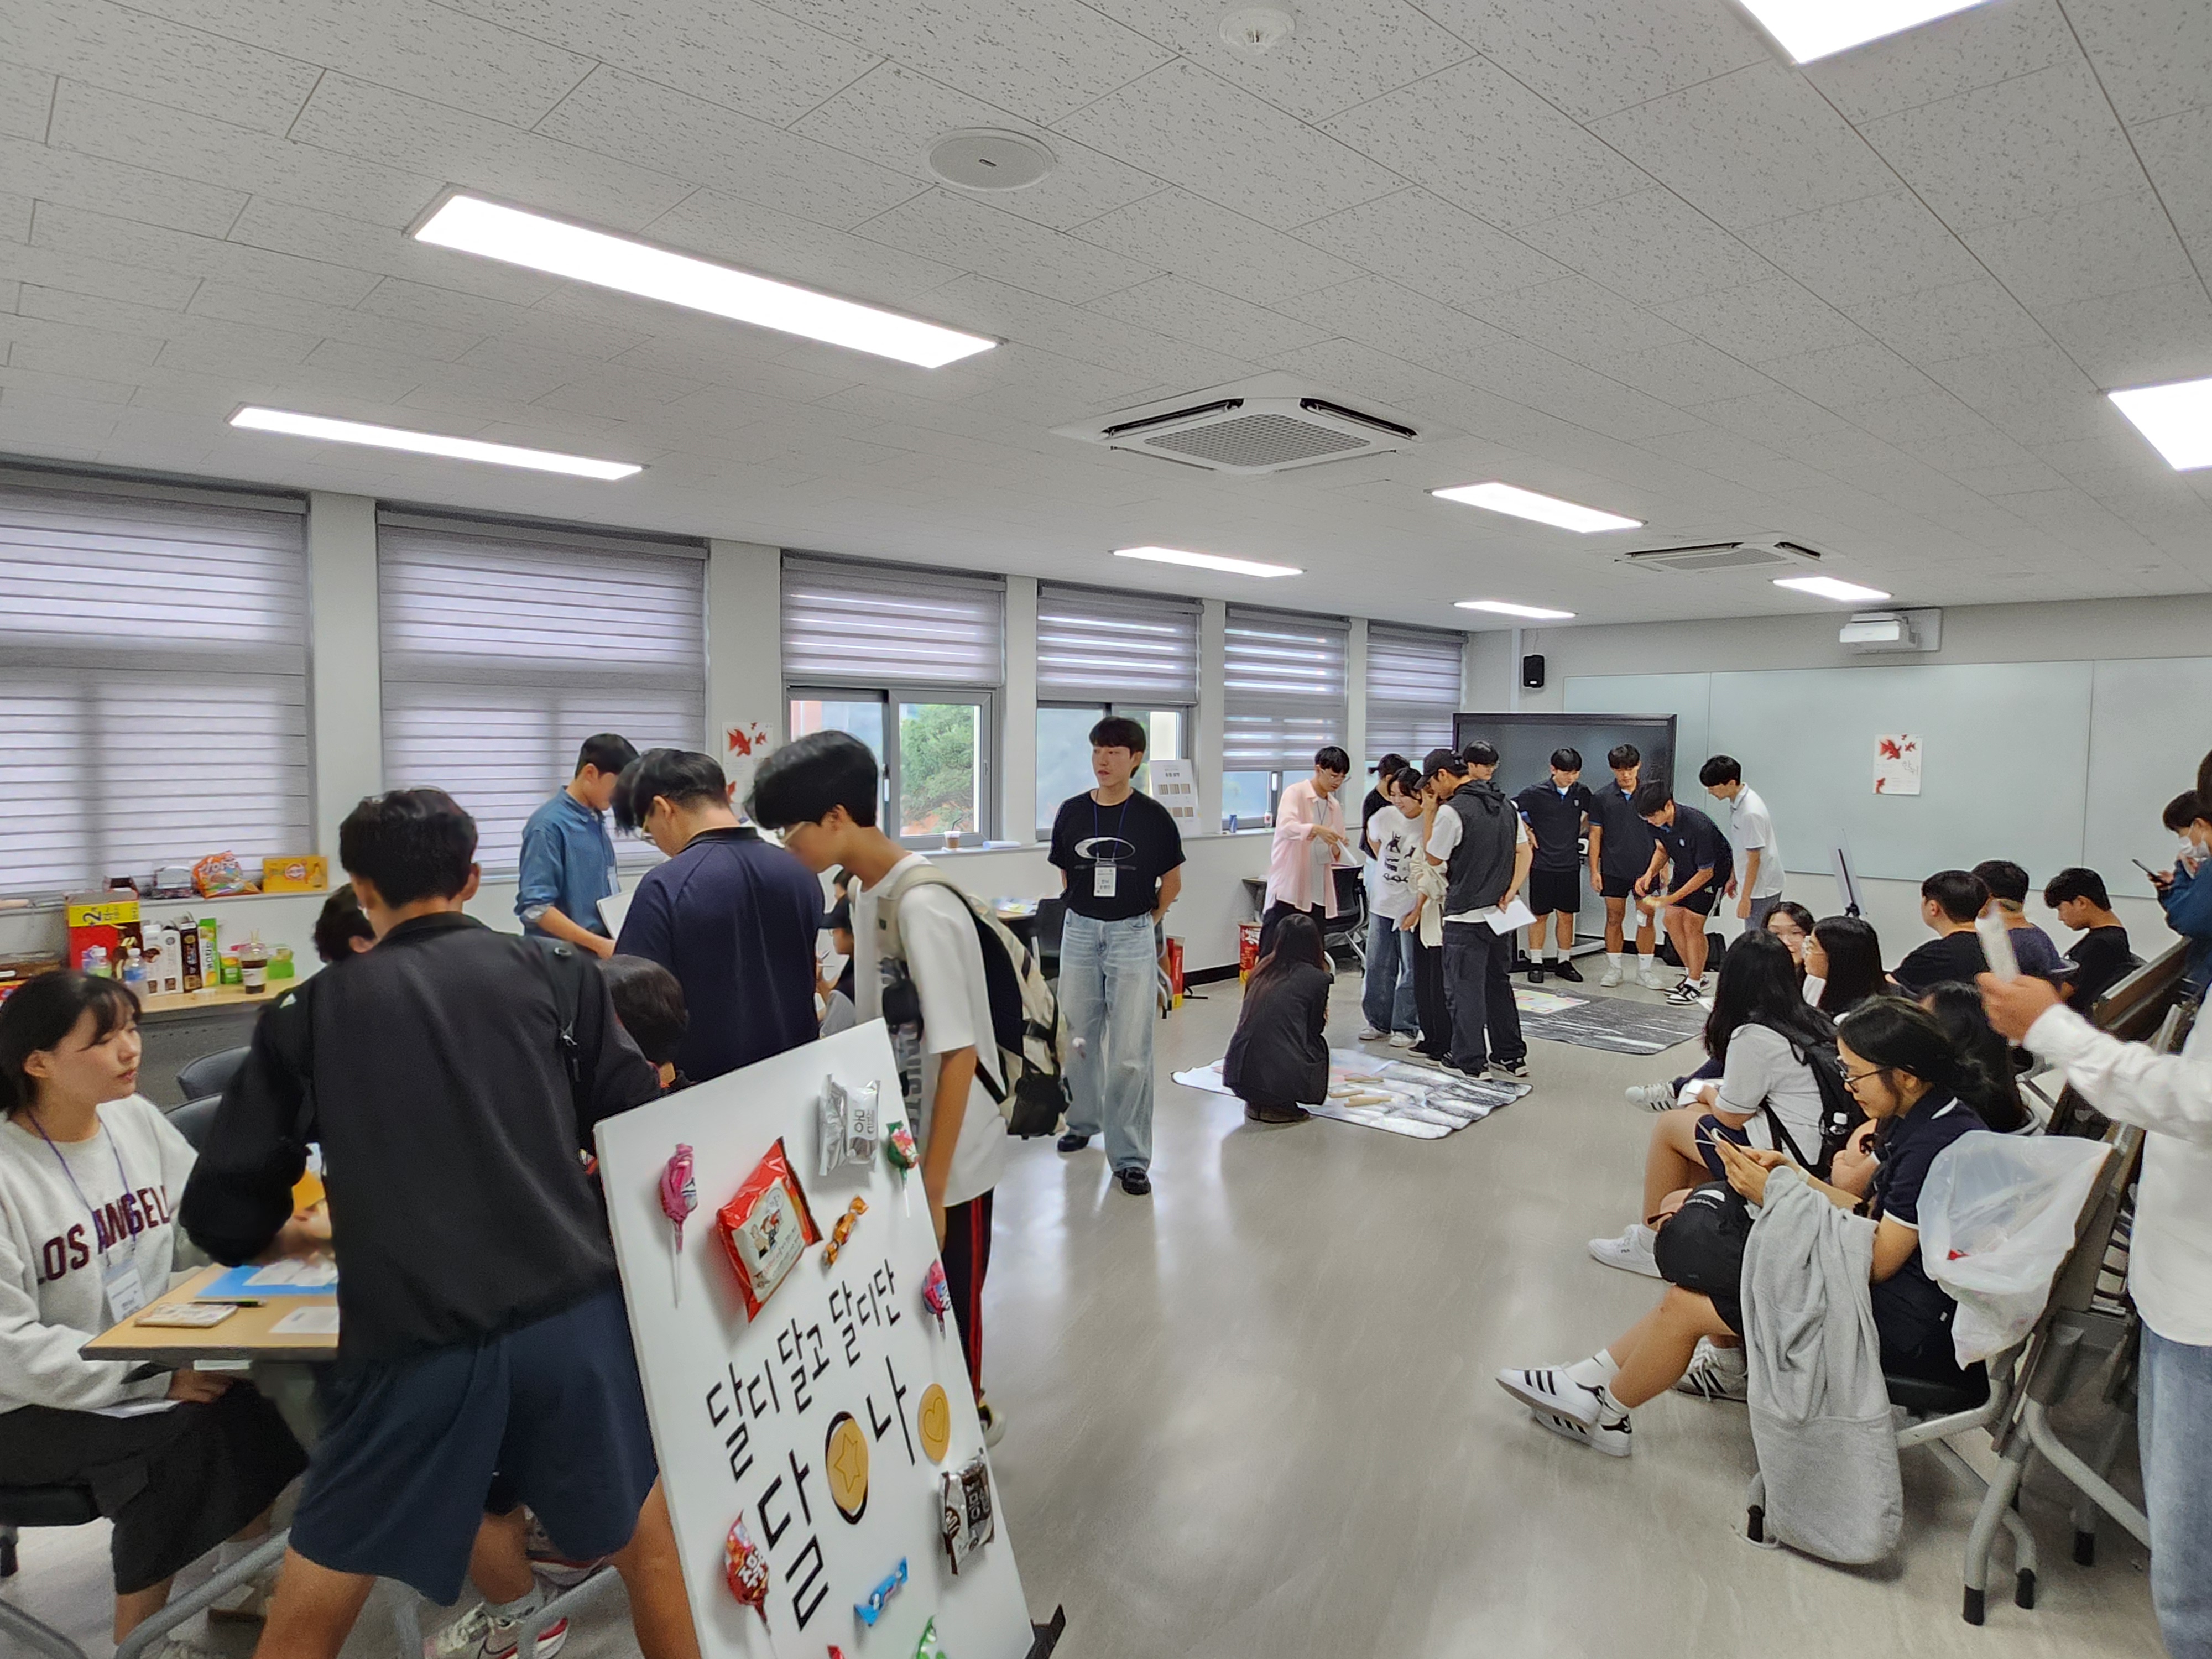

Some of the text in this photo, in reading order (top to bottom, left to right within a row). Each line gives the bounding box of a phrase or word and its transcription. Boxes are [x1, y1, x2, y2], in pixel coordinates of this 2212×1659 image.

[38, 1185, 170, 1285] OS ANGEL
[706, 1258, 901, 1483] 달디 달고 달디단
